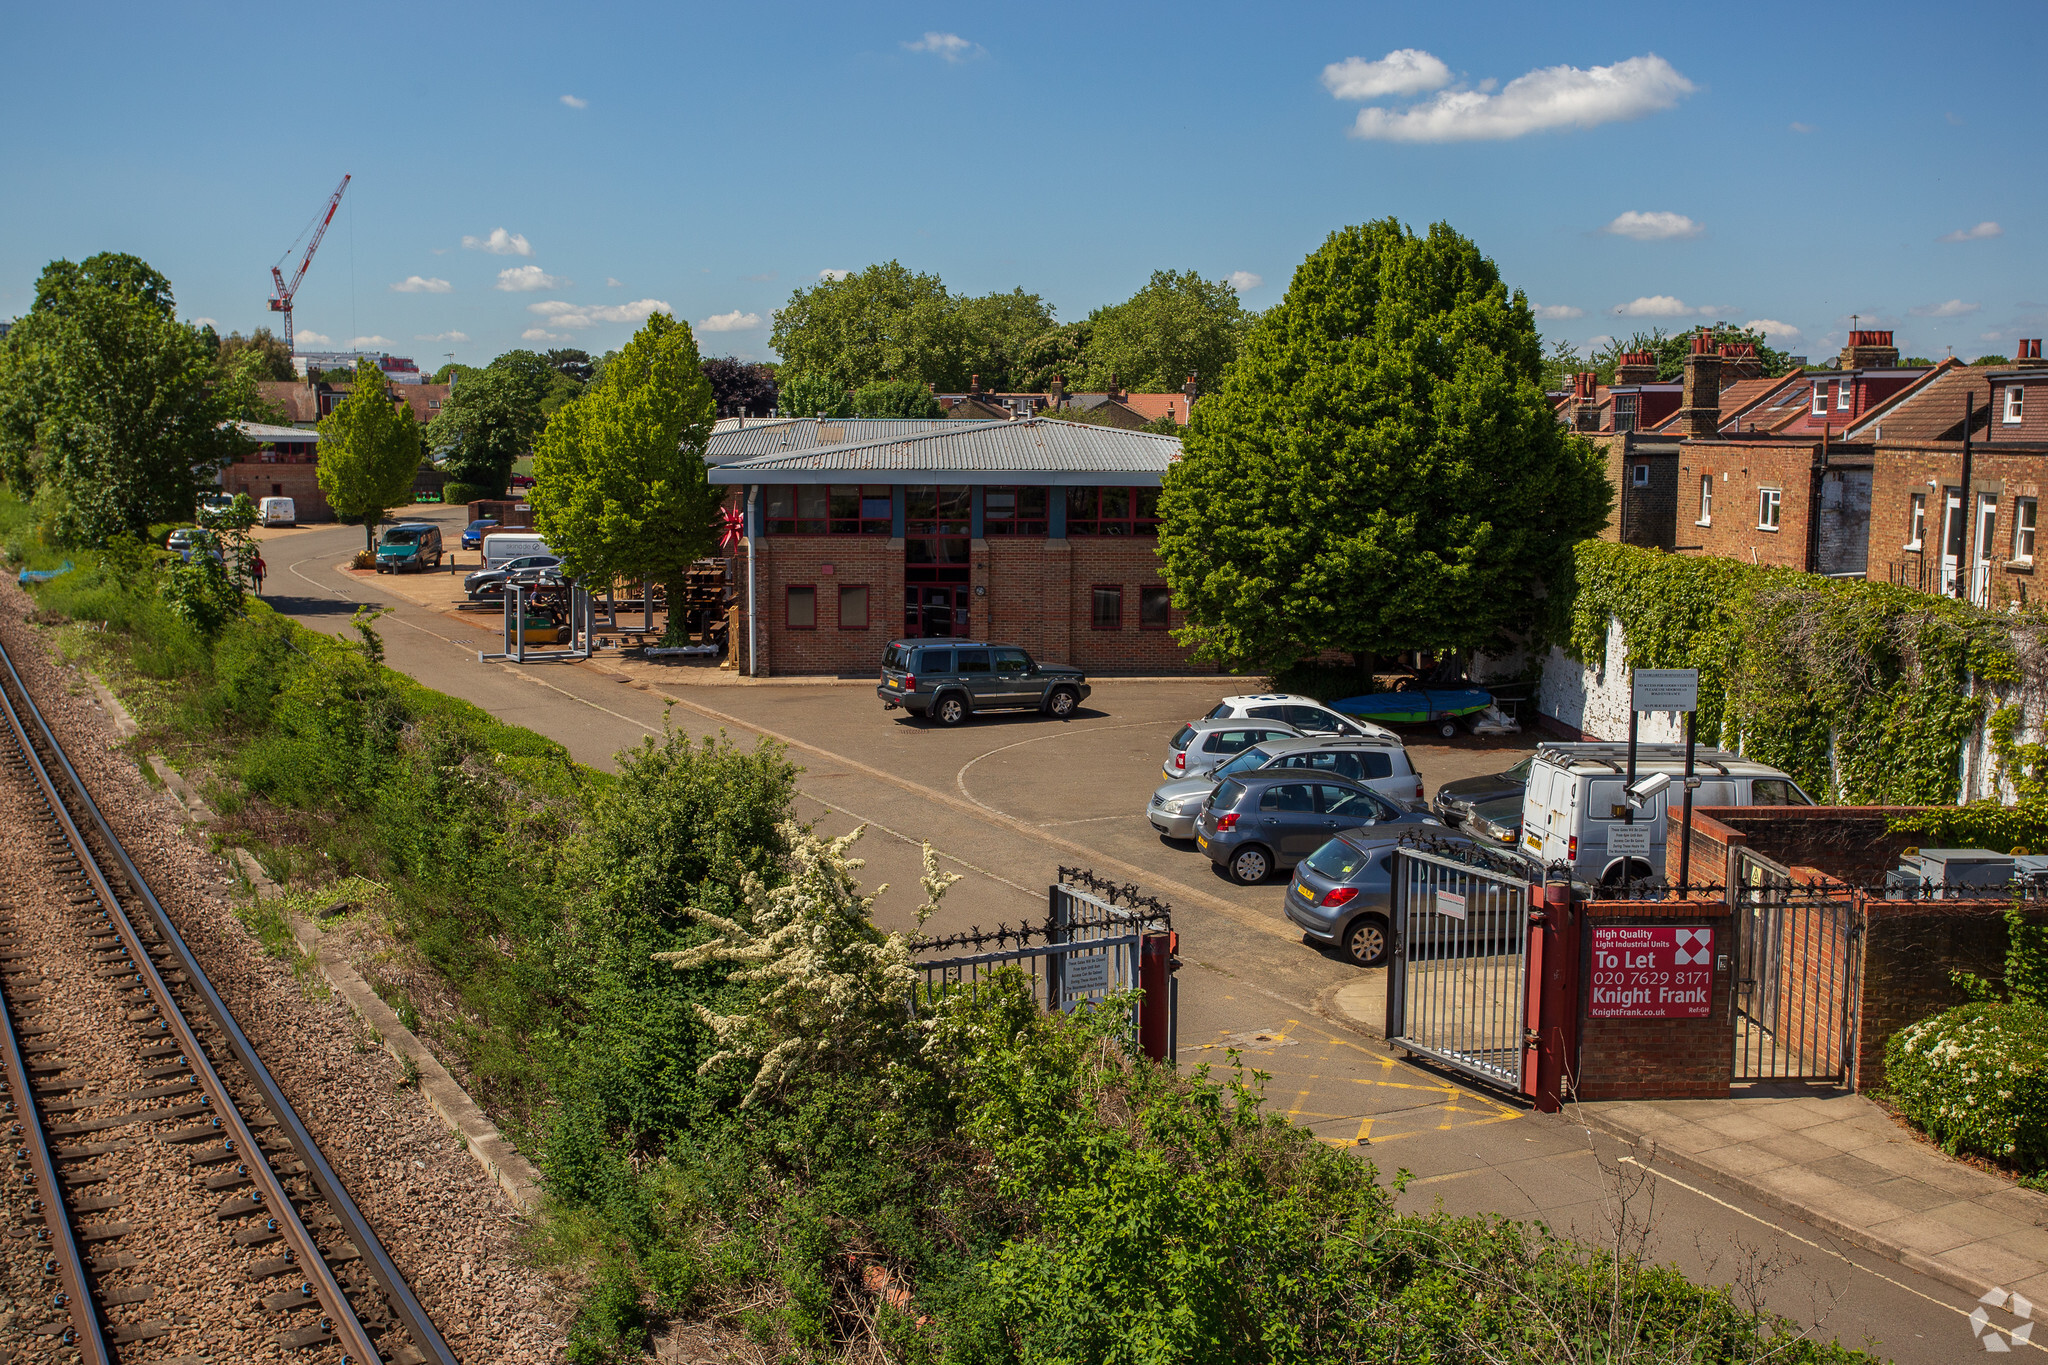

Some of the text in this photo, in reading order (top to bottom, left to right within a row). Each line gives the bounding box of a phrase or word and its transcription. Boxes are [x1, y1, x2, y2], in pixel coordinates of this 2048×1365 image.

[1596, 930, 1653, 940] High Quality
[1596, 951, 1656, 969] To Let
[1594, 972, 1709, 985] 020 7629 8171
[1593, 987, 1707, 1008] Knight Frank
[1592, 1008, 1665, 1017] KnightFrank.co.uk
